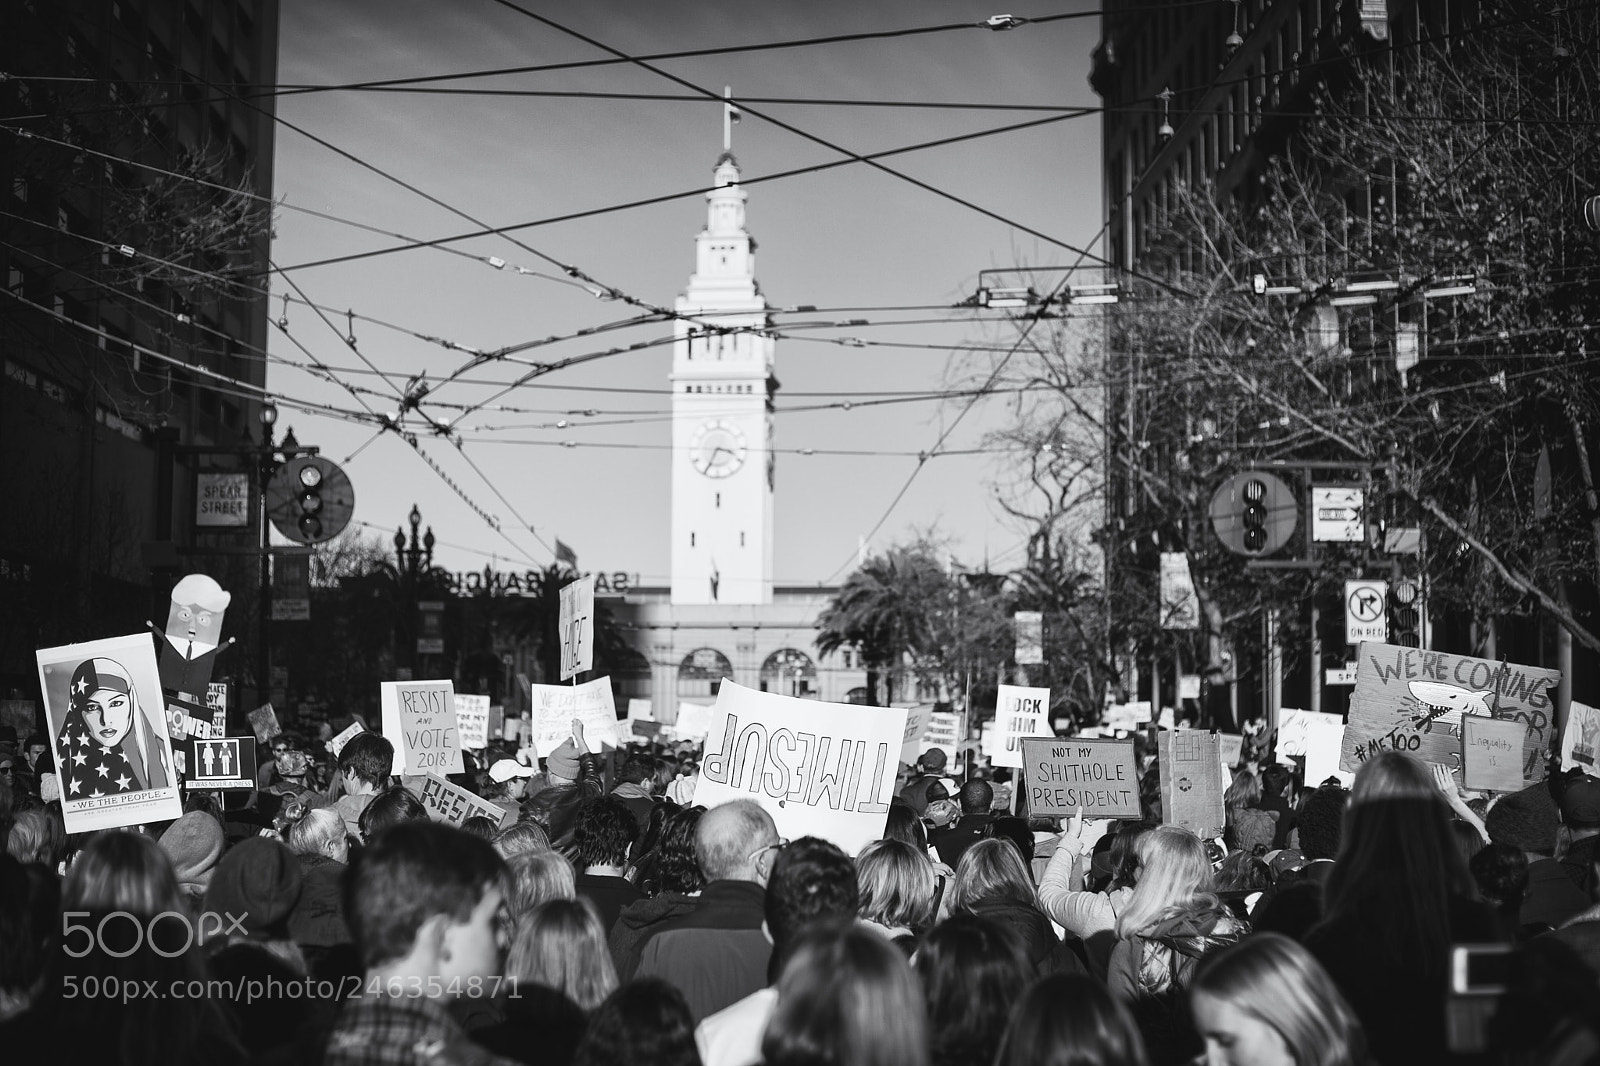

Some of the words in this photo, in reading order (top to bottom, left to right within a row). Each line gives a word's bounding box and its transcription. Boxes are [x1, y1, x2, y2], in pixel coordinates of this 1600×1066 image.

[203, 485, 242, 498] SPEAR
[201, 501, 242, 514] STREET
[1350, 627, 1363, 638] ON
[1366, 627, 1384, 638] RED
[1369, 650, 1450, 685] WE'RE
[1453, 658, 1553, 709] COMING
[401, 690, 448, 714] RESIST
[416, 717, 433, 725] AND
[1006, 716, 1036, 734] HIM
[406, 727, 455, 750] VOTE
[1467, 722, 1513, 751] Inequality
[1052, 747, 1071, 758] NOT
[1078, 747, 1092, 758] MY
[1037, 762, 1126, 783] SHITHOLE
[195, 780, 207, 788] WAS
[207, 780, 227, 788] NEVER
[233, 780, 251, 788] DRESS
[77, 800, 94, 809] WE
[97, 796, 118, 807] THE
[121, 790, 161, 803] PEOPLE
[1032, 787, 1132, 807] PRESIDENT
